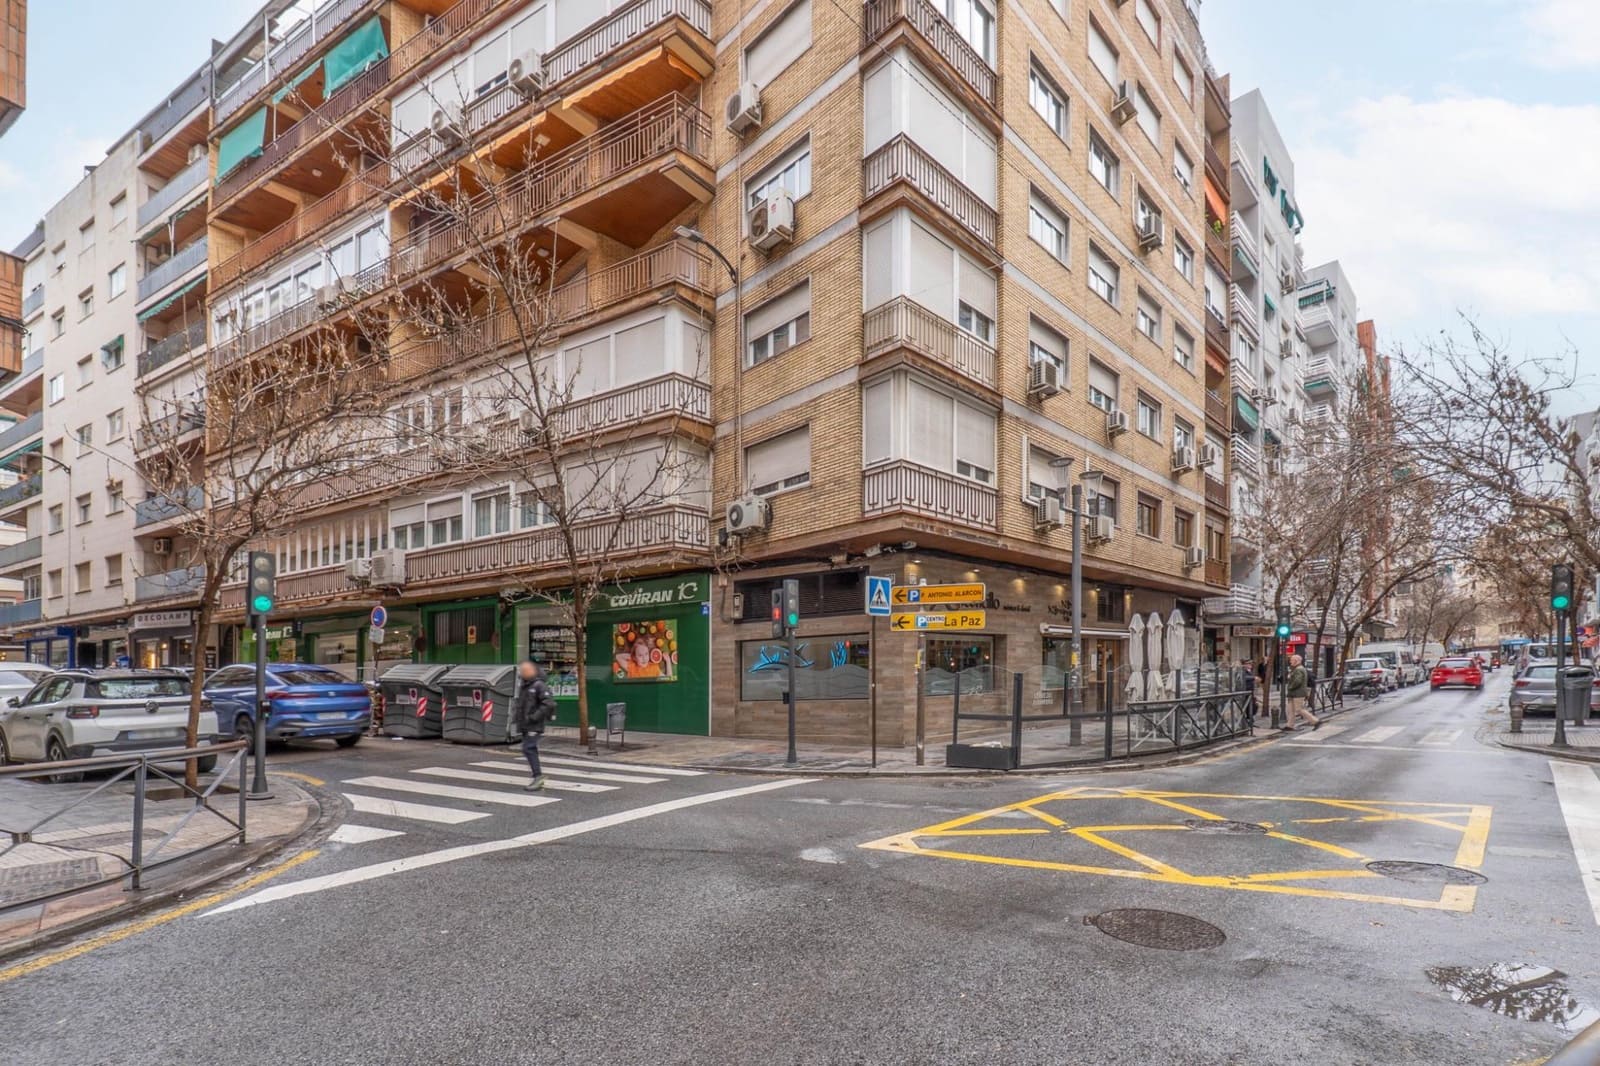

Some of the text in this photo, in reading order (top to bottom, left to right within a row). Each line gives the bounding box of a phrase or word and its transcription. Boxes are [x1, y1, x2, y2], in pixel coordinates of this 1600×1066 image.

[138, 613, 188, 622] DECOLAMP
[944, 616, 957, 626] La
[961, 615, 981, 626] Paz
